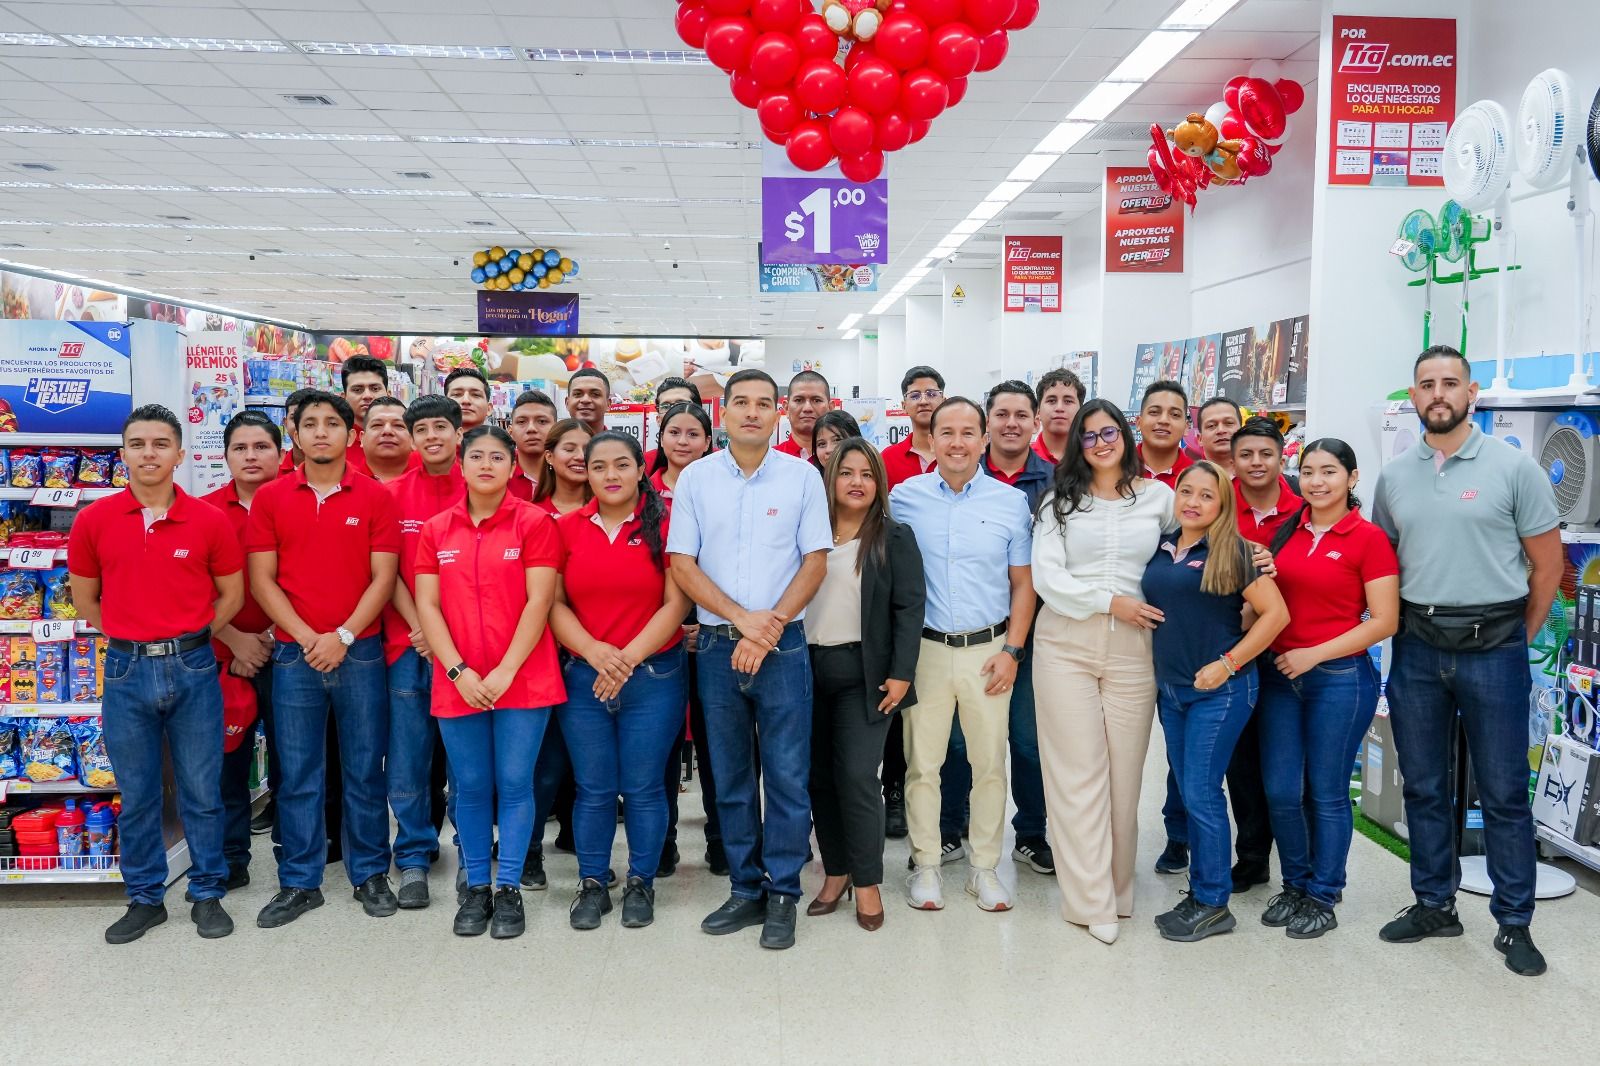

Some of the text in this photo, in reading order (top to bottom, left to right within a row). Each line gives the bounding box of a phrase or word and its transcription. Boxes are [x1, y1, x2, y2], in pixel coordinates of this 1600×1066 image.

[1341, 28, 1366, 39] POR
[1347, 83, 1441, 94] ENCUENTRA TODO
[1346, 94, 1441, 105] LO QUE NECESITAS
[1352, 105, 1434, 115] PARA TU HOGAR
[1115, 174, 1156, 184] APROVE
[1120, 183, 1159, 193] NUESTR
[1115, 226, 1175, 238] APROVECHA
[1119, 236, 1170, 247] NUESTRAS
[771, 267, 808, 277] COMPRAS
[771, 276, 801, 286] GRATIS
[528, 308, 569, 324] Hogar
[108, 328, 122, 341] DC
[186, 344, 237, 356] LLÉNATE DE
[187, 356, 238, 368] PREMIOS
[13, 366, 64, 374] SUPERHÉROES
[215, 373, 227, 382] 25
[30, 379, 88, 393] JUSTICE
[36, 392, 84, 408] LEAGUE
